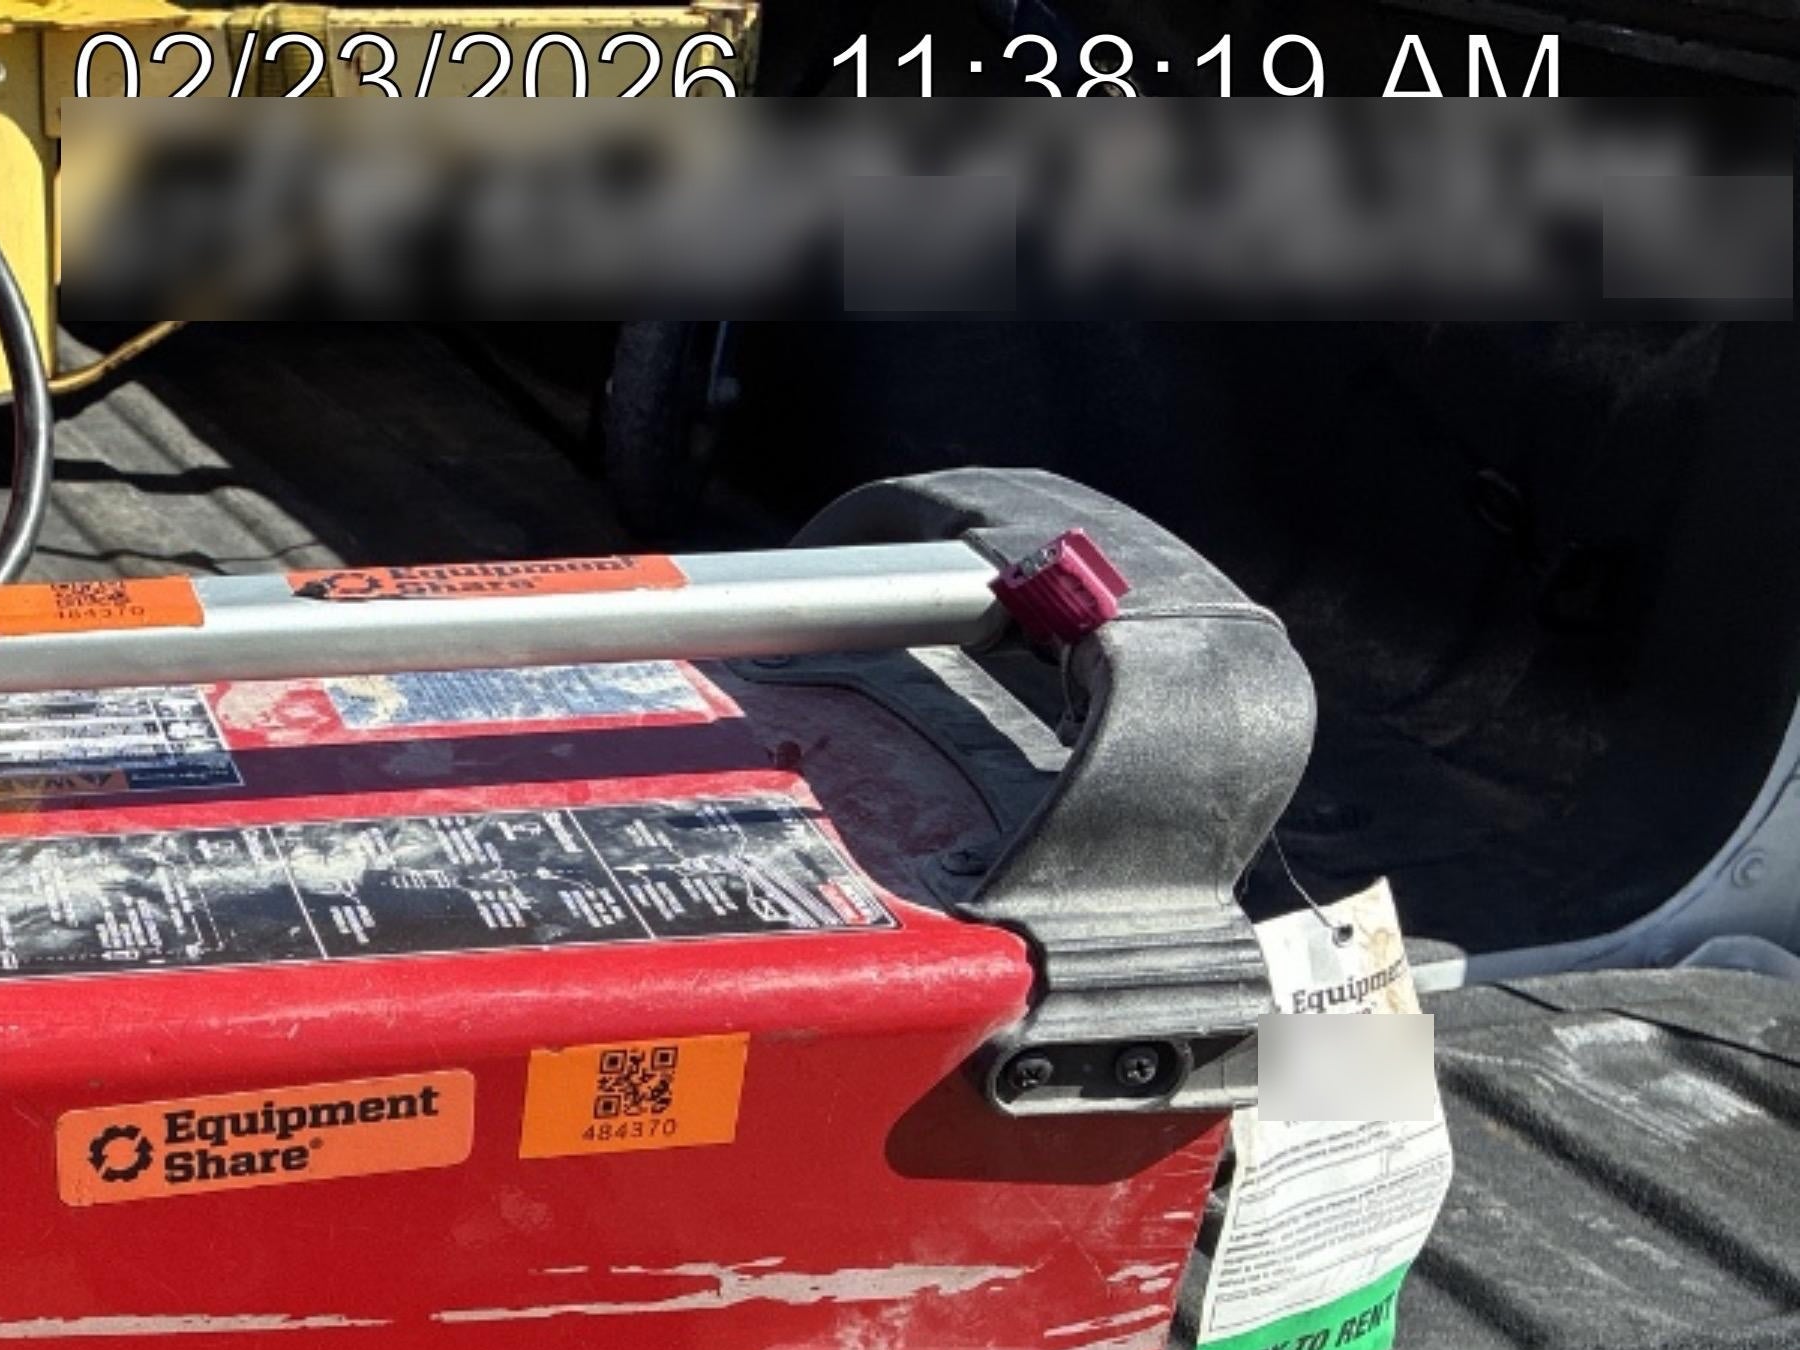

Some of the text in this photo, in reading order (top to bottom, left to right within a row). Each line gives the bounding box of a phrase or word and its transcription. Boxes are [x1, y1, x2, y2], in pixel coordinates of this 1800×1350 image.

[389, 555, 636, 582] Equipment
[396, 575, 538, 594] Share
[163, 1085, 440, 1147] Equipment
[581, 1117, 678, 1143] 484370
[163, 1146, 310, 1185] Share
[1335, 1291, 1396, 1348] RENT
